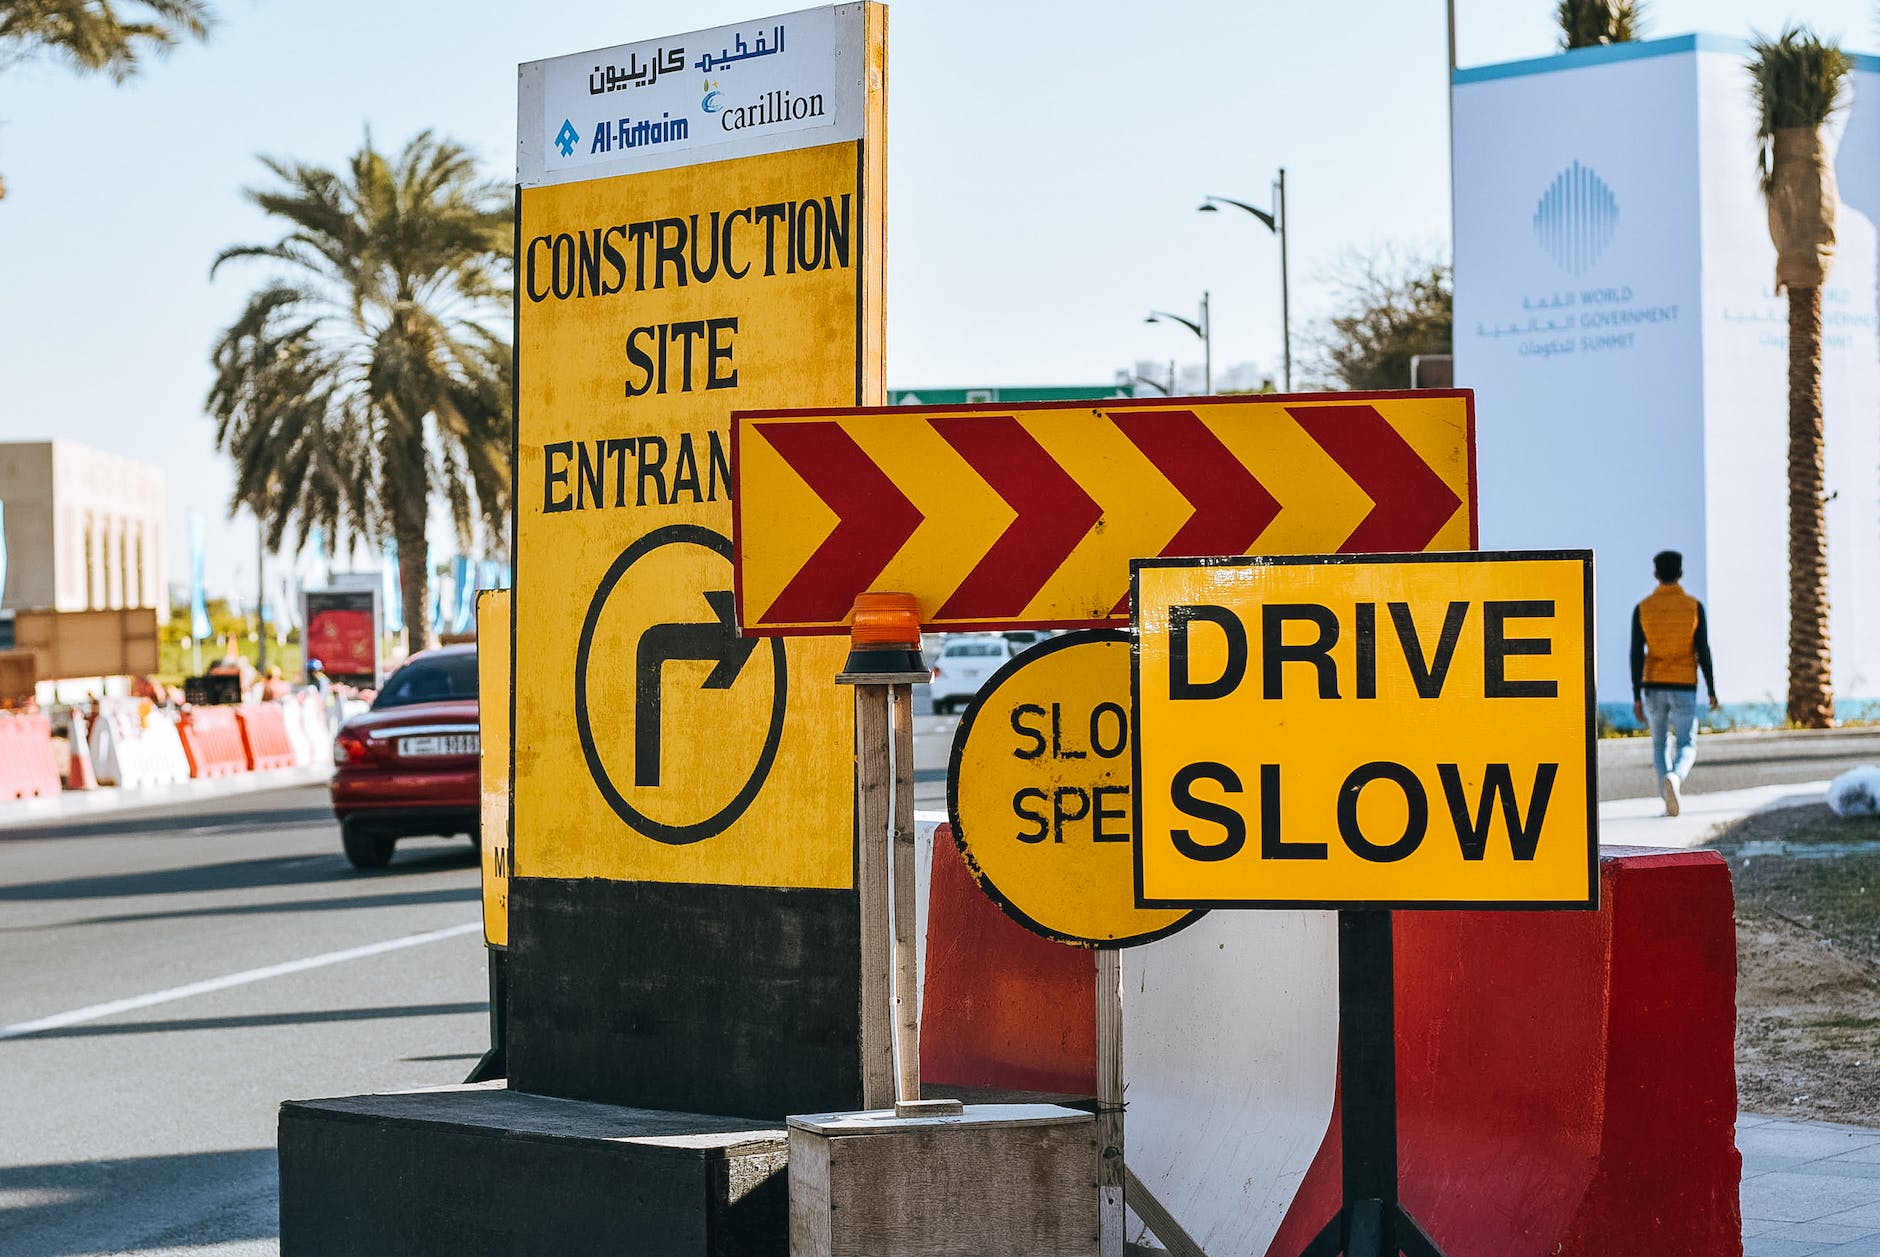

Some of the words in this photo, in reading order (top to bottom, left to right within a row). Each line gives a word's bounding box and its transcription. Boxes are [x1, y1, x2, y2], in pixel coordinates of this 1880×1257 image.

[589, 47, 685, 96] كاريليون
[694, 25, 785, 74] الفطيم
[590, 111, 689, 155] Al-Futtaim
[721, 90, 825, 132] carillion
[526, 193, 851, 303] CONSTRUCTION
[1580, 285, 1633, 305] WORLD
[1580, 304, 1680, 329] GOVERNMENT
[624, 316, 739, 398] SITE
[1580, 331, 1635, 353] SUMMIT
[1168, 600, 1558, 701] DRIVE
[1010, 701, 1128, 761] SLO
[1012, 785, 1130, 844] SPE
[1169, 761, 1559, 863] SLOW
